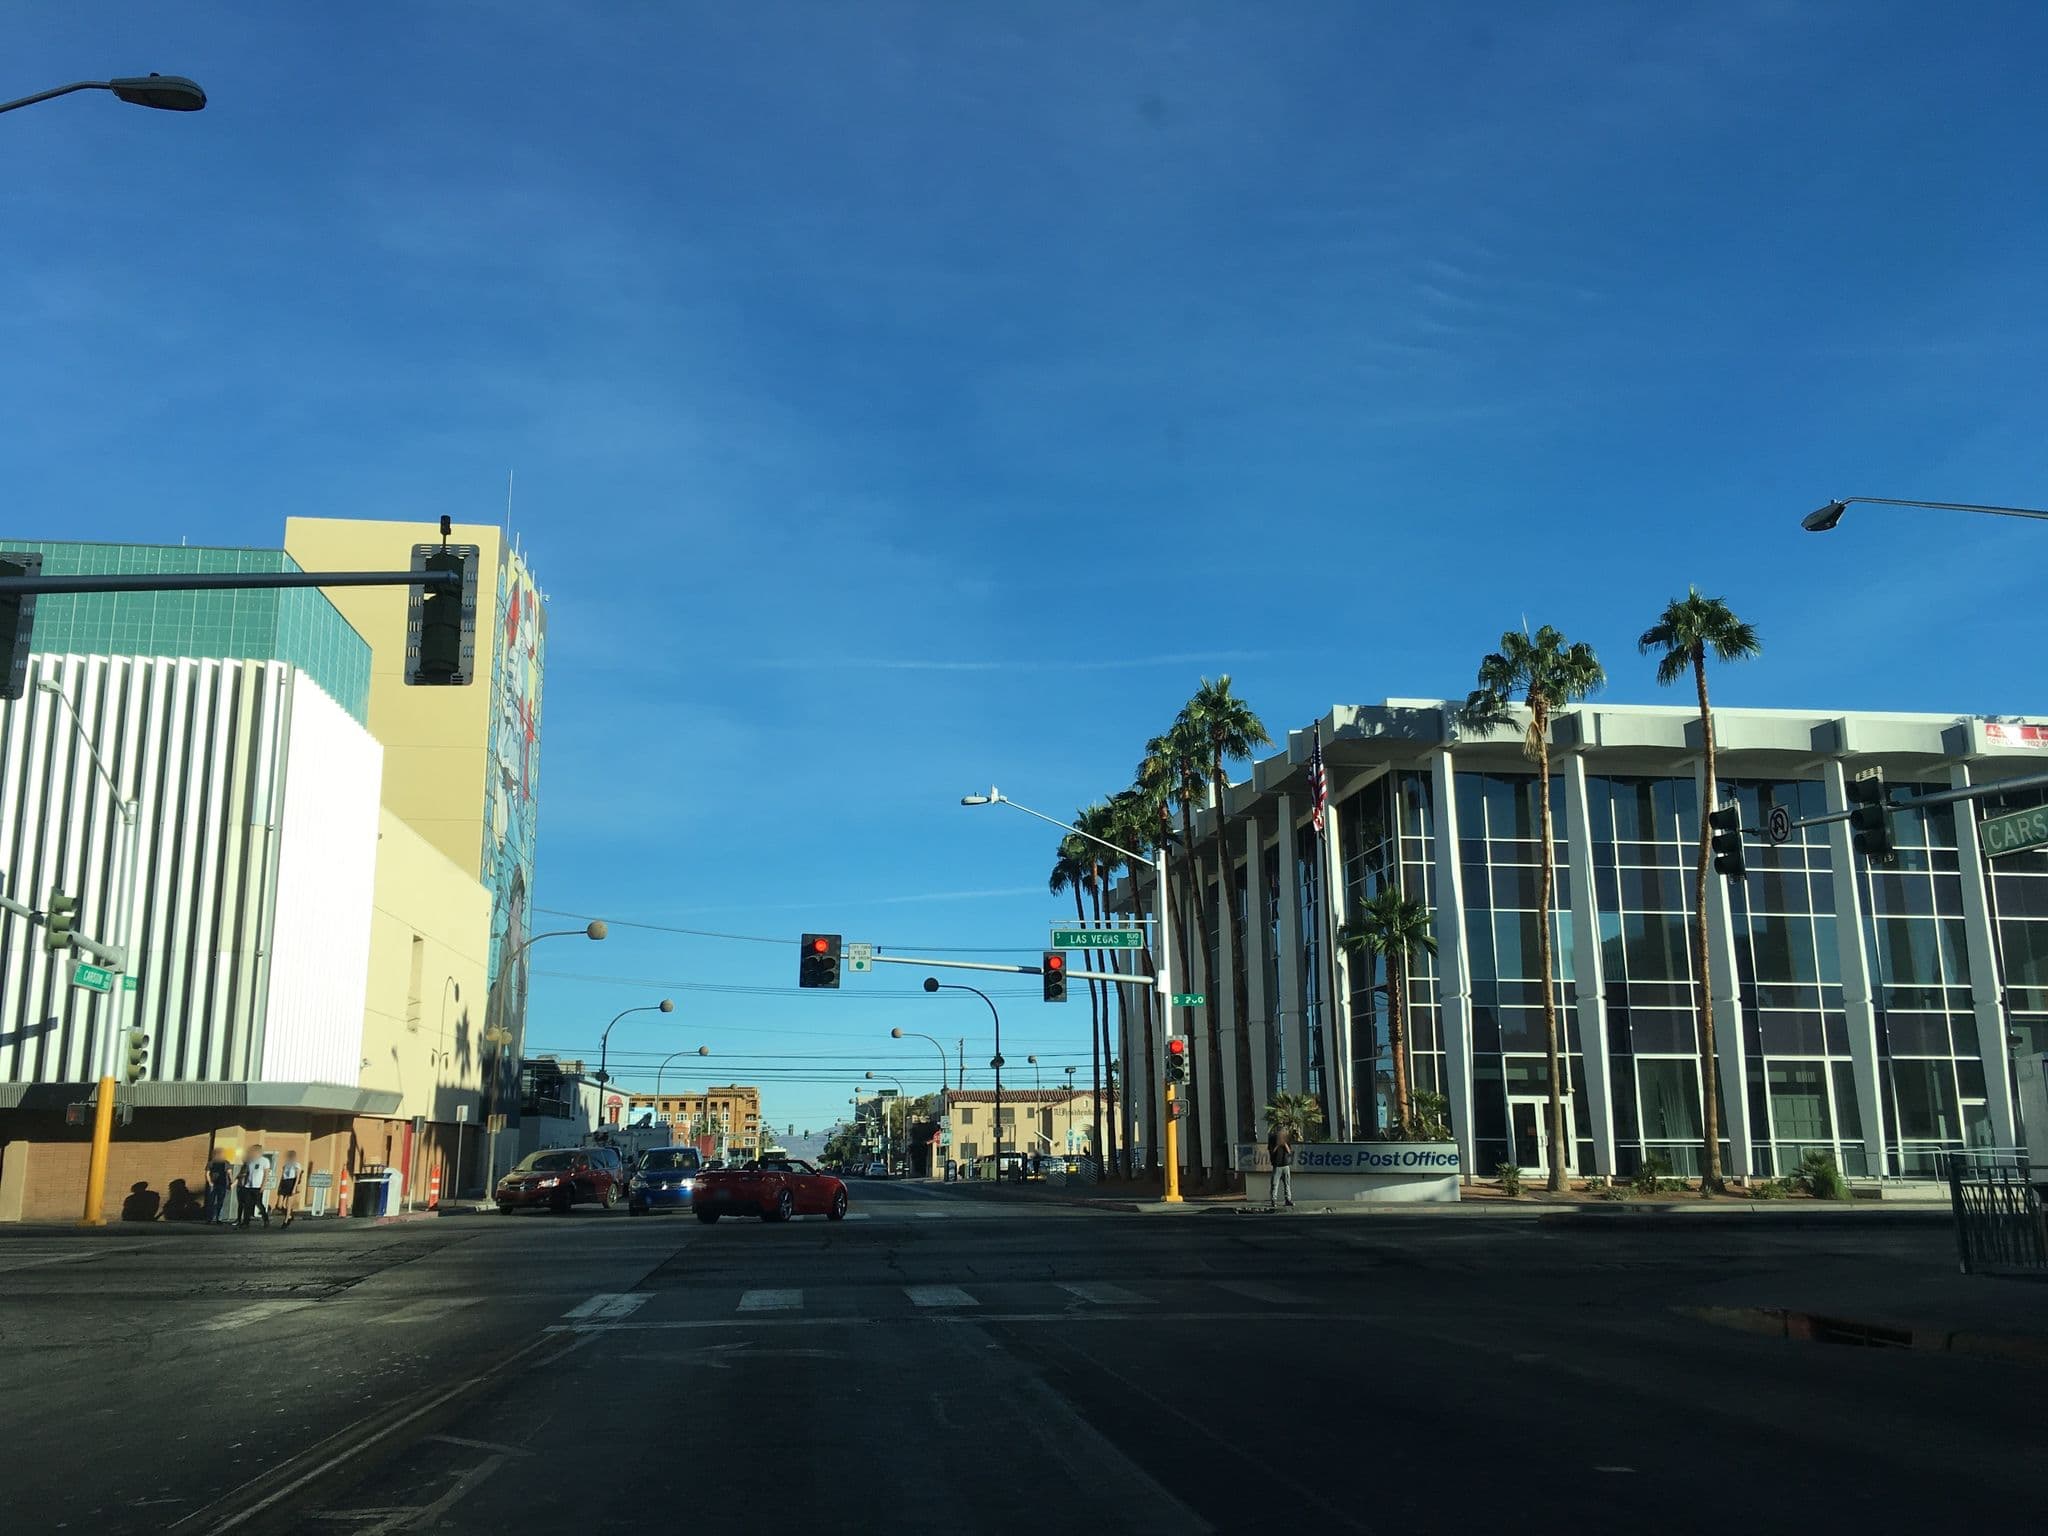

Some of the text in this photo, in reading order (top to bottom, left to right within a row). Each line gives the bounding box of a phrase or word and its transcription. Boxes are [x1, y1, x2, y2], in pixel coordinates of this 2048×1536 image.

[1988, 813, 2048, 849] CARS
[1070, 935, 1119, 944] LAS VEGAS
[1173, 996, 1178, 1004] S
[1298, 1151, 1352, 1166] States
[1356, 1151, 1401, 1166] Post
[1403, 1151, 1458, 1166] Office
